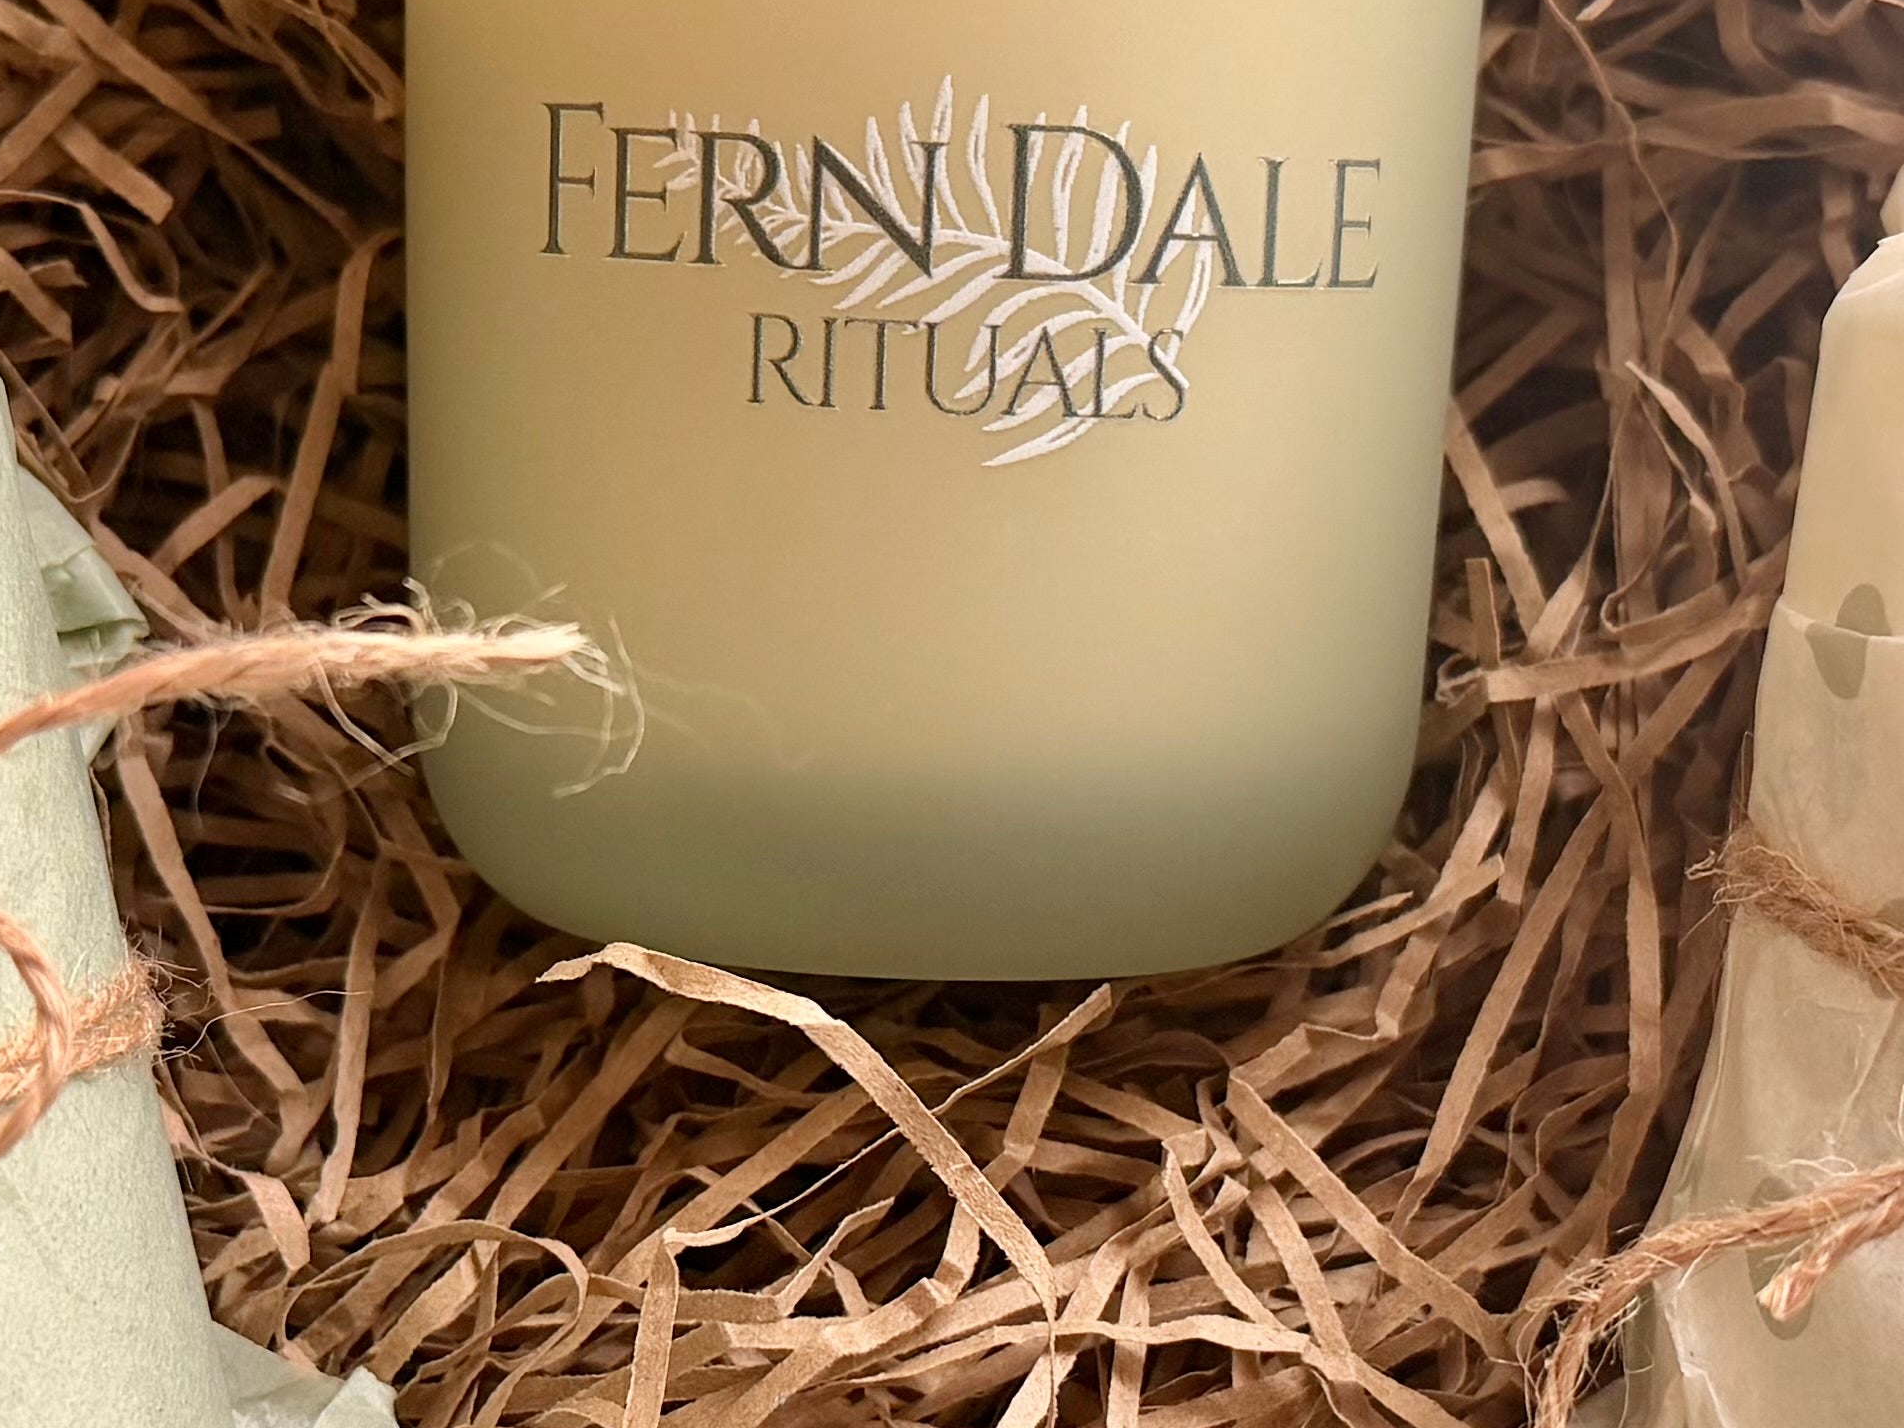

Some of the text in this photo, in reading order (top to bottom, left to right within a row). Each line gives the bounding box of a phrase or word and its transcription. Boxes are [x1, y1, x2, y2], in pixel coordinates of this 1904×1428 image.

[540, 101, 1384, 290] FERN DALE
[746, 312, 1189, 424] RITUALS
